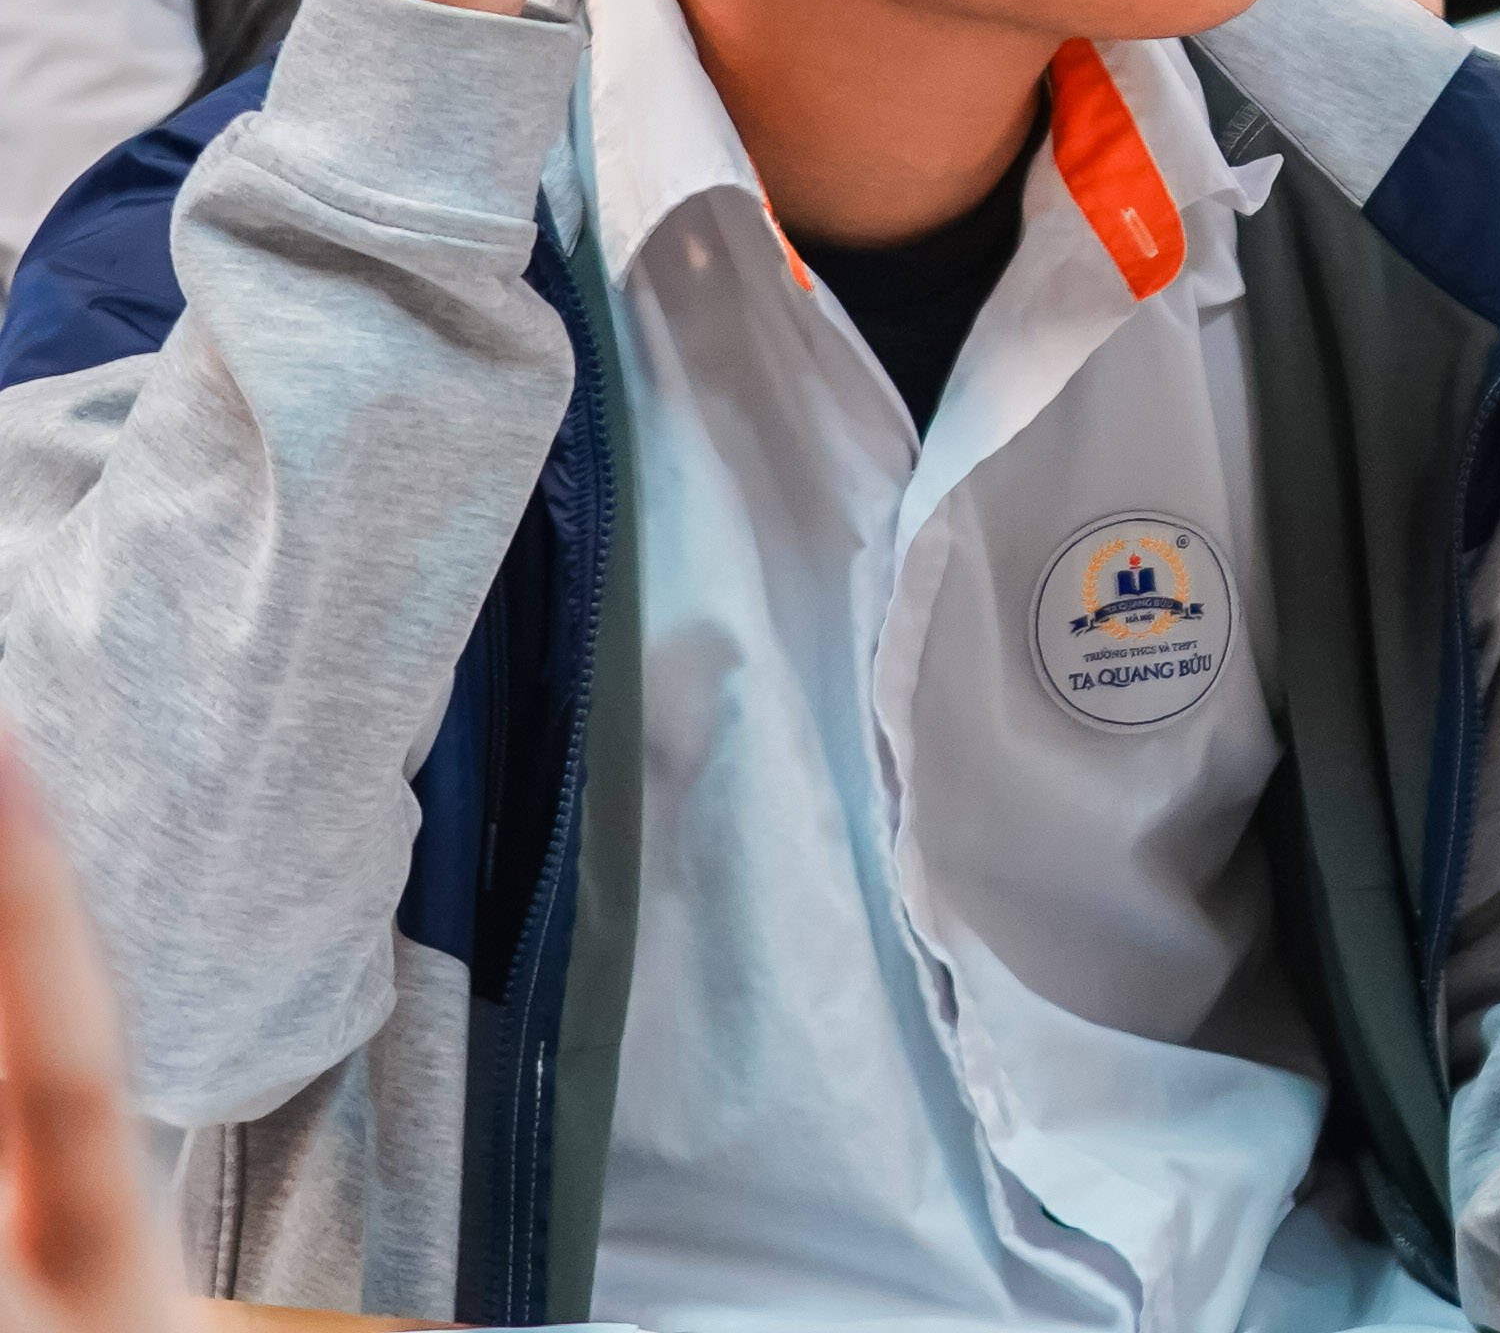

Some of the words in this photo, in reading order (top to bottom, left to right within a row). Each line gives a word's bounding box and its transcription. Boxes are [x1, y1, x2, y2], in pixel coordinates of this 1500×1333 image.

[1069, 673, 1096, 691] TẠ
[1098, 661, 1174, 688] QUANG
[1178, 652, 1212, 678] BỬU
